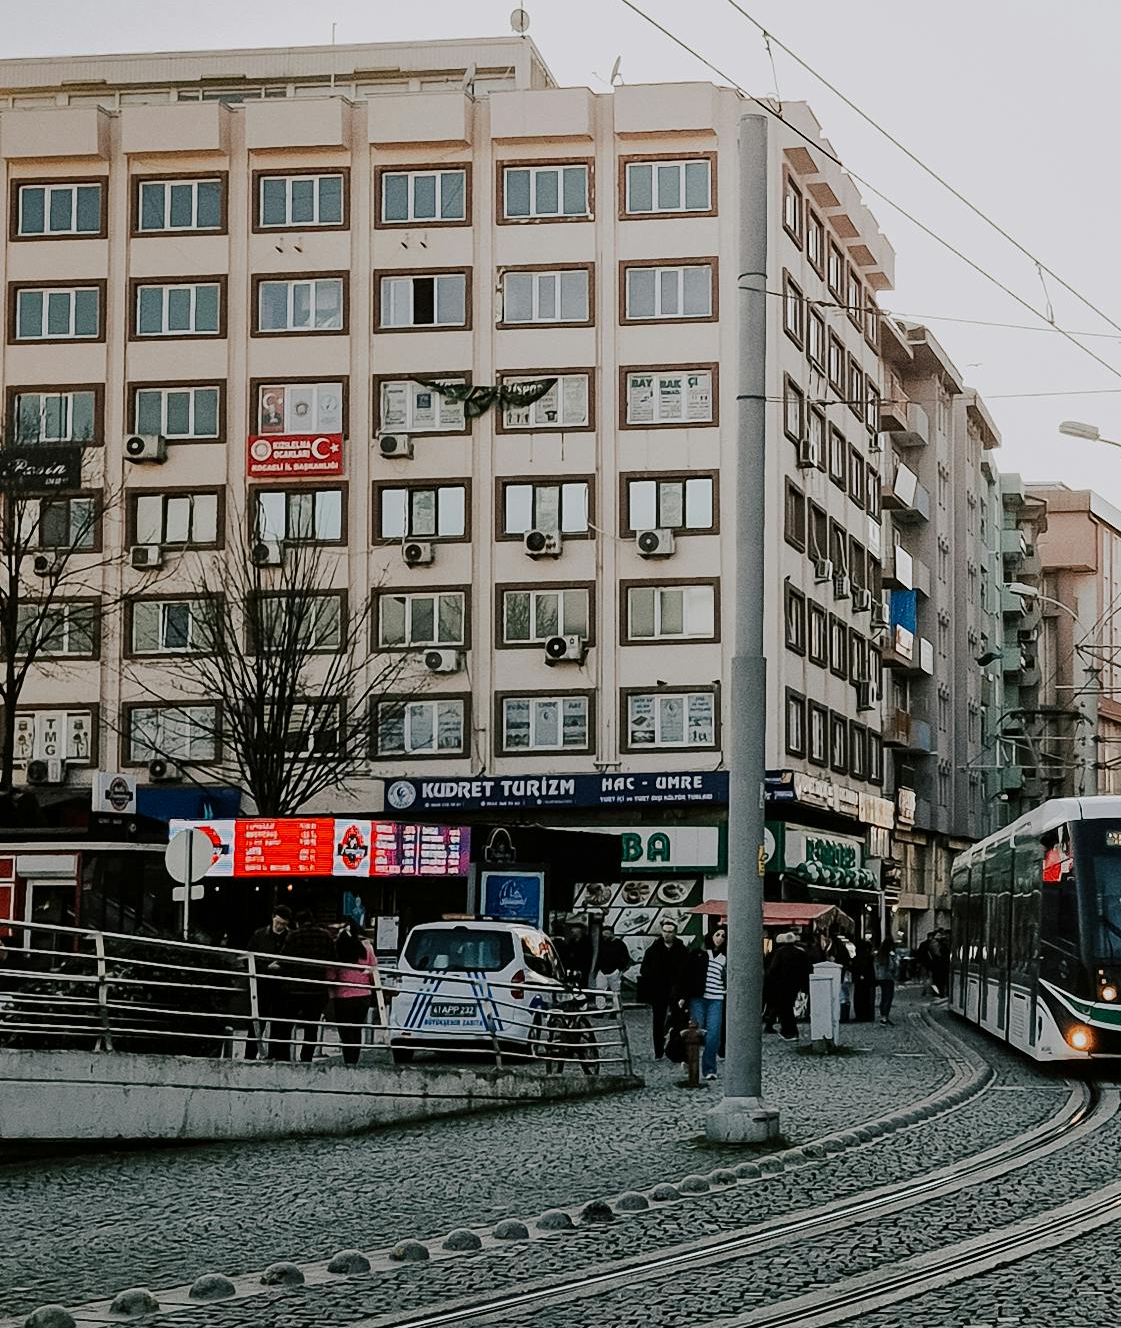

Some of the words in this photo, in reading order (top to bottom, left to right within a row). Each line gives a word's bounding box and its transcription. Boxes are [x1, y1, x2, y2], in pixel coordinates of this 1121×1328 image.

[631, 379, 653, 388] BAY
[422, 780, 494, 799] KUDRET
[500, 776, 575, 797] TURİZM
[601, 777, 636, 792] HAC
[655, 775, 704, 790] UMRE
